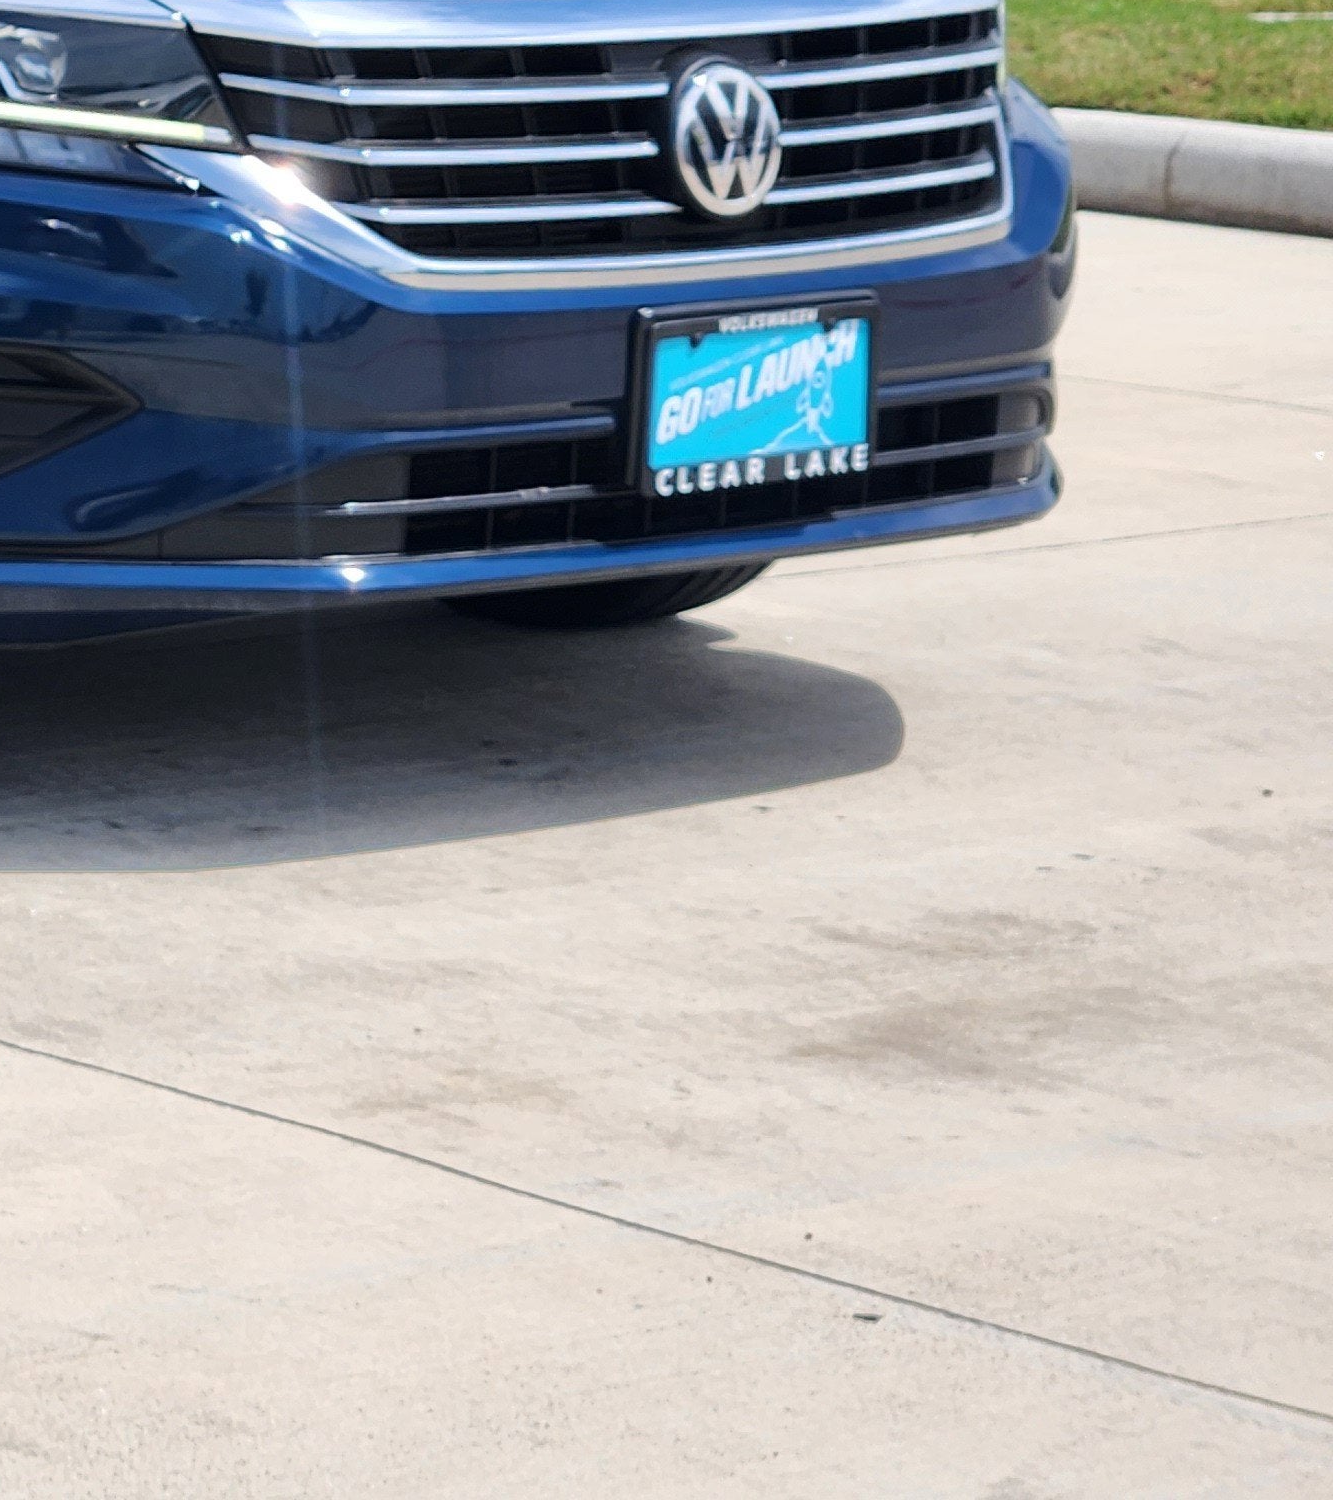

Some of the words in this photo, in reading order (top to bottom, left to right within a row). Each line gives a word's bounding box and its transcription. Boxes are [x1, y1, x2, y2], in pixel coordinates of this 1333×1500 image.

[679, 67, 780, 212] VW
[655, 386, 702, 445] GO
[736, 318, 859, 411] LAUNCH
[655, 457, 766, 497] CLEAR
[784, 443, 870, 480] LAKE
